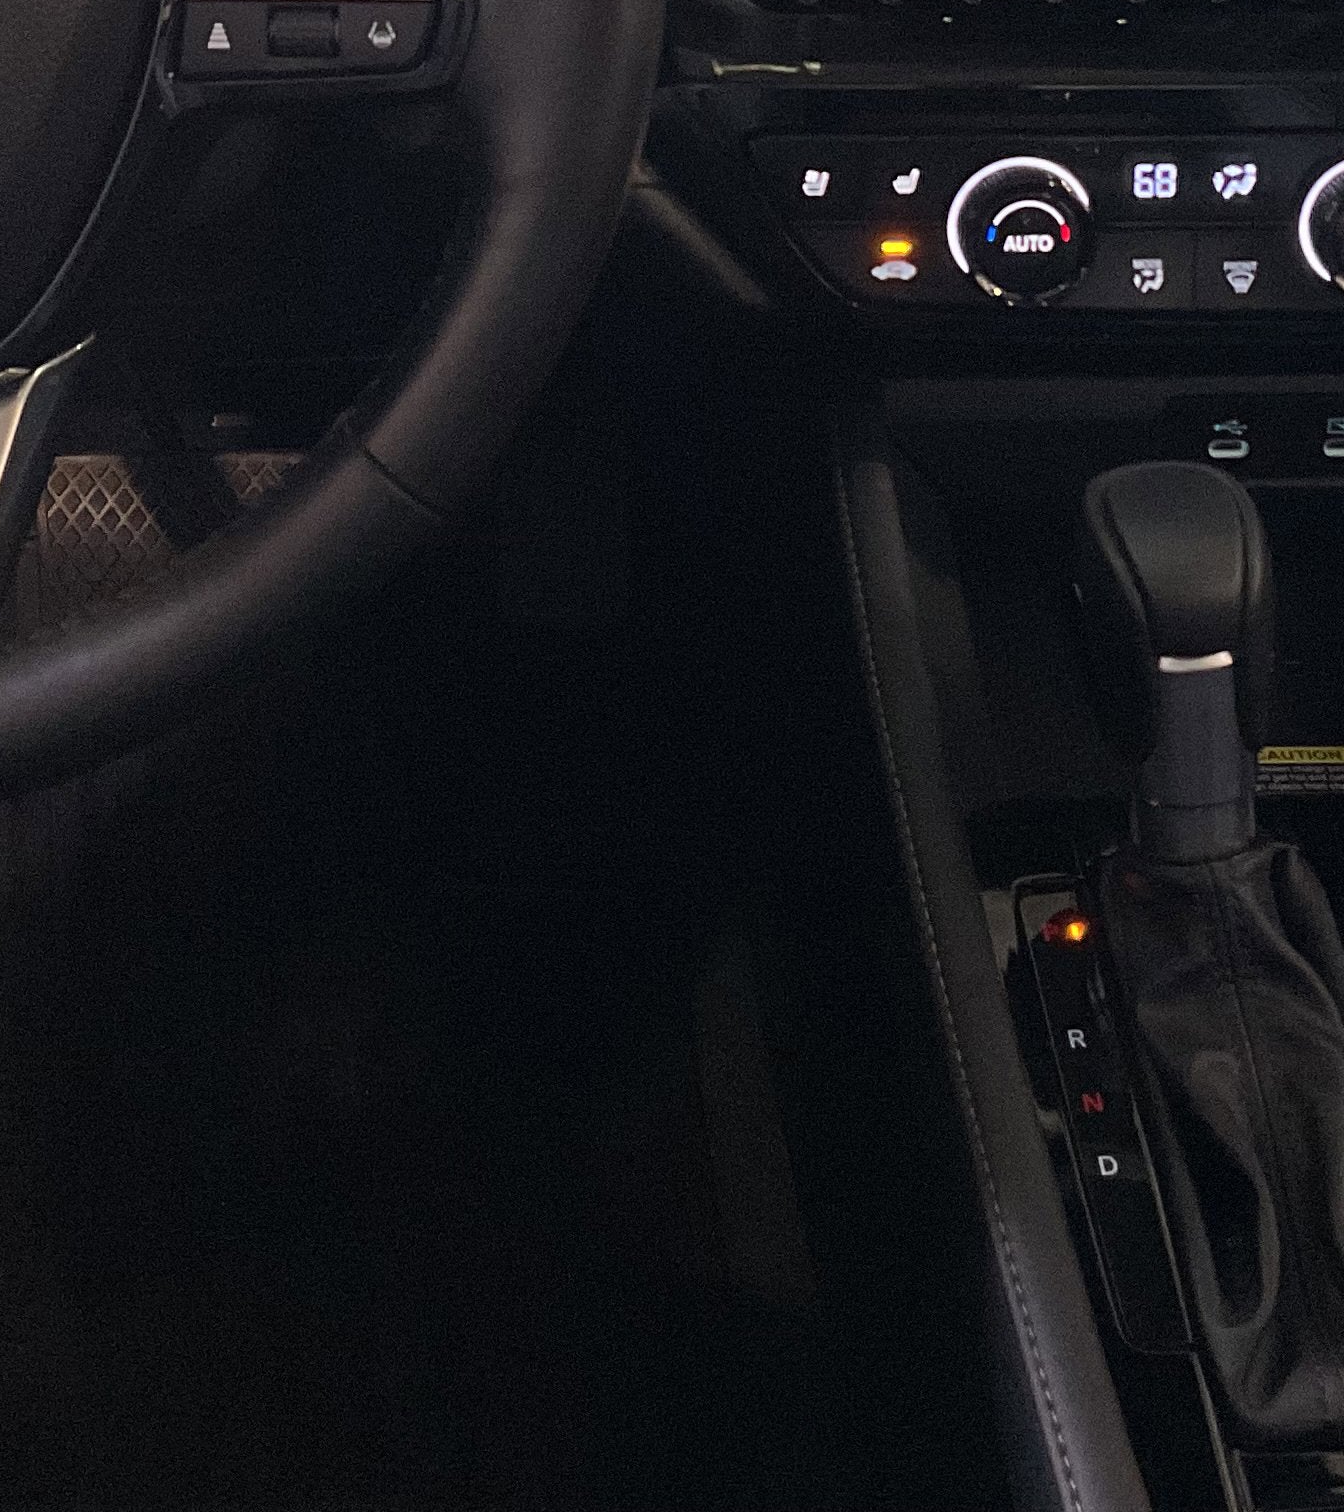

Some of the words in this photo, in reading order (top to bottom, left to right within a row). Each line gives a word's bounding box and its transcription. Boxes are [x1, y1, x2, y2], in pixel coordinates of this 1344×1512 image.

[1132, 162, 1178, 199] 68
[1002, 233, 1054, 254] AUTO
[1067, 1029, 1087, 1049] R
[1082, 1092, 1104, 1113] N
[1098, 1155, 1118, 1175] D
